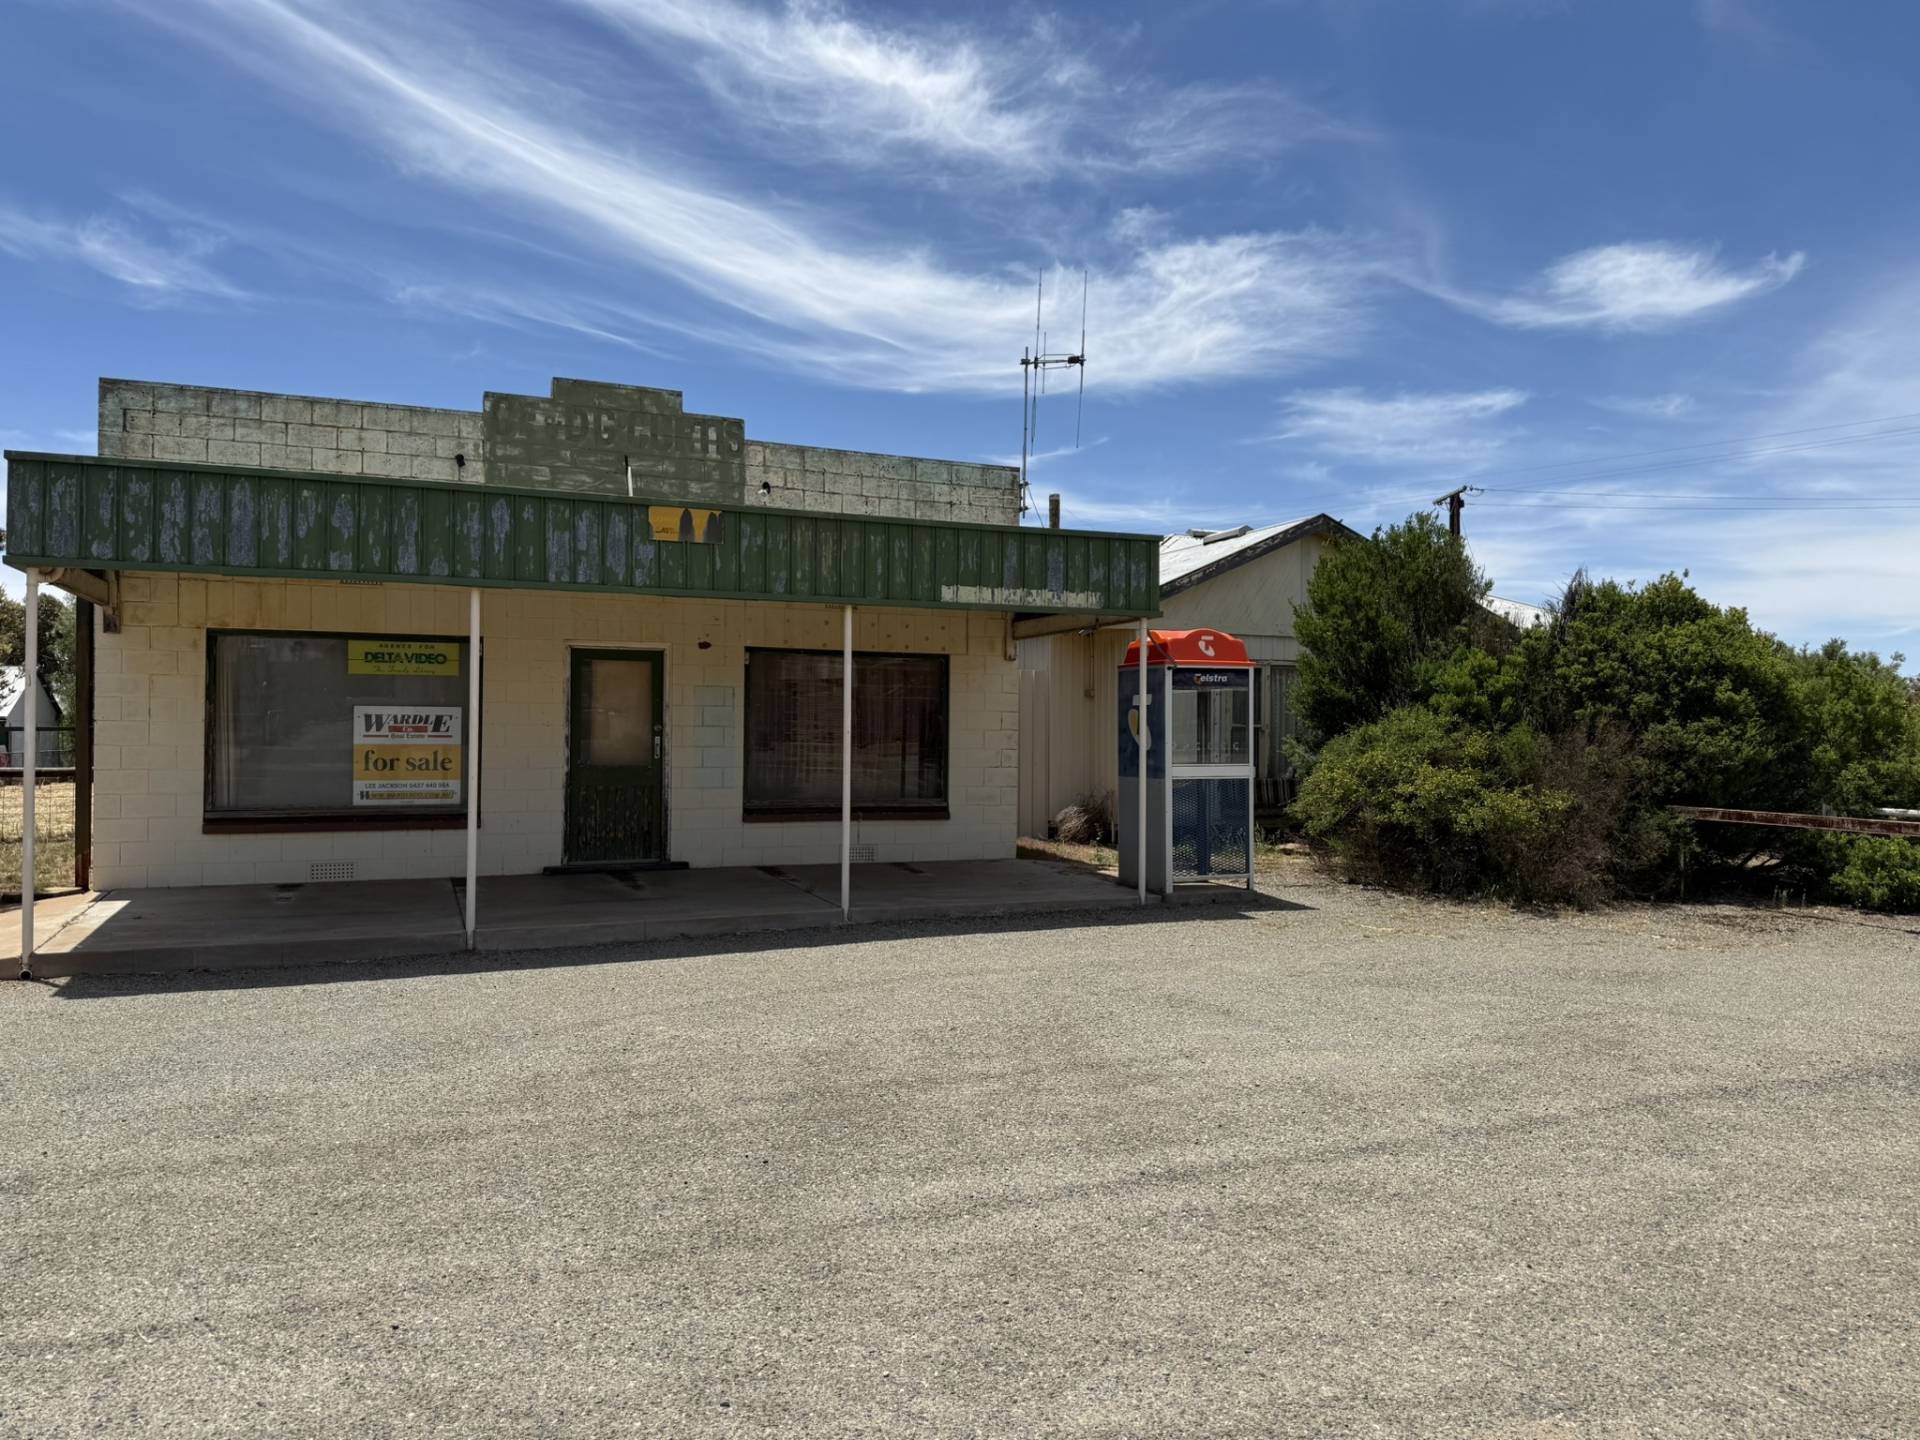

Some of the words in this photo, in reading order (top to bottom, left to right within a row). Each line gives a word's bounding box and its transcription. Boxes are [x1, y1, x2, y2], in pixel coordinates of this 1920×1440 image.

[364, 651, 403, 664] DELTA
[404, 652, 448, 665] VIDEO
[1192, 673, 1228, 685] Telstra
[364, 713, 453, 733] WARDLE
[364, 749, 400, 771] for
[405, 750, 453, 771] sale
